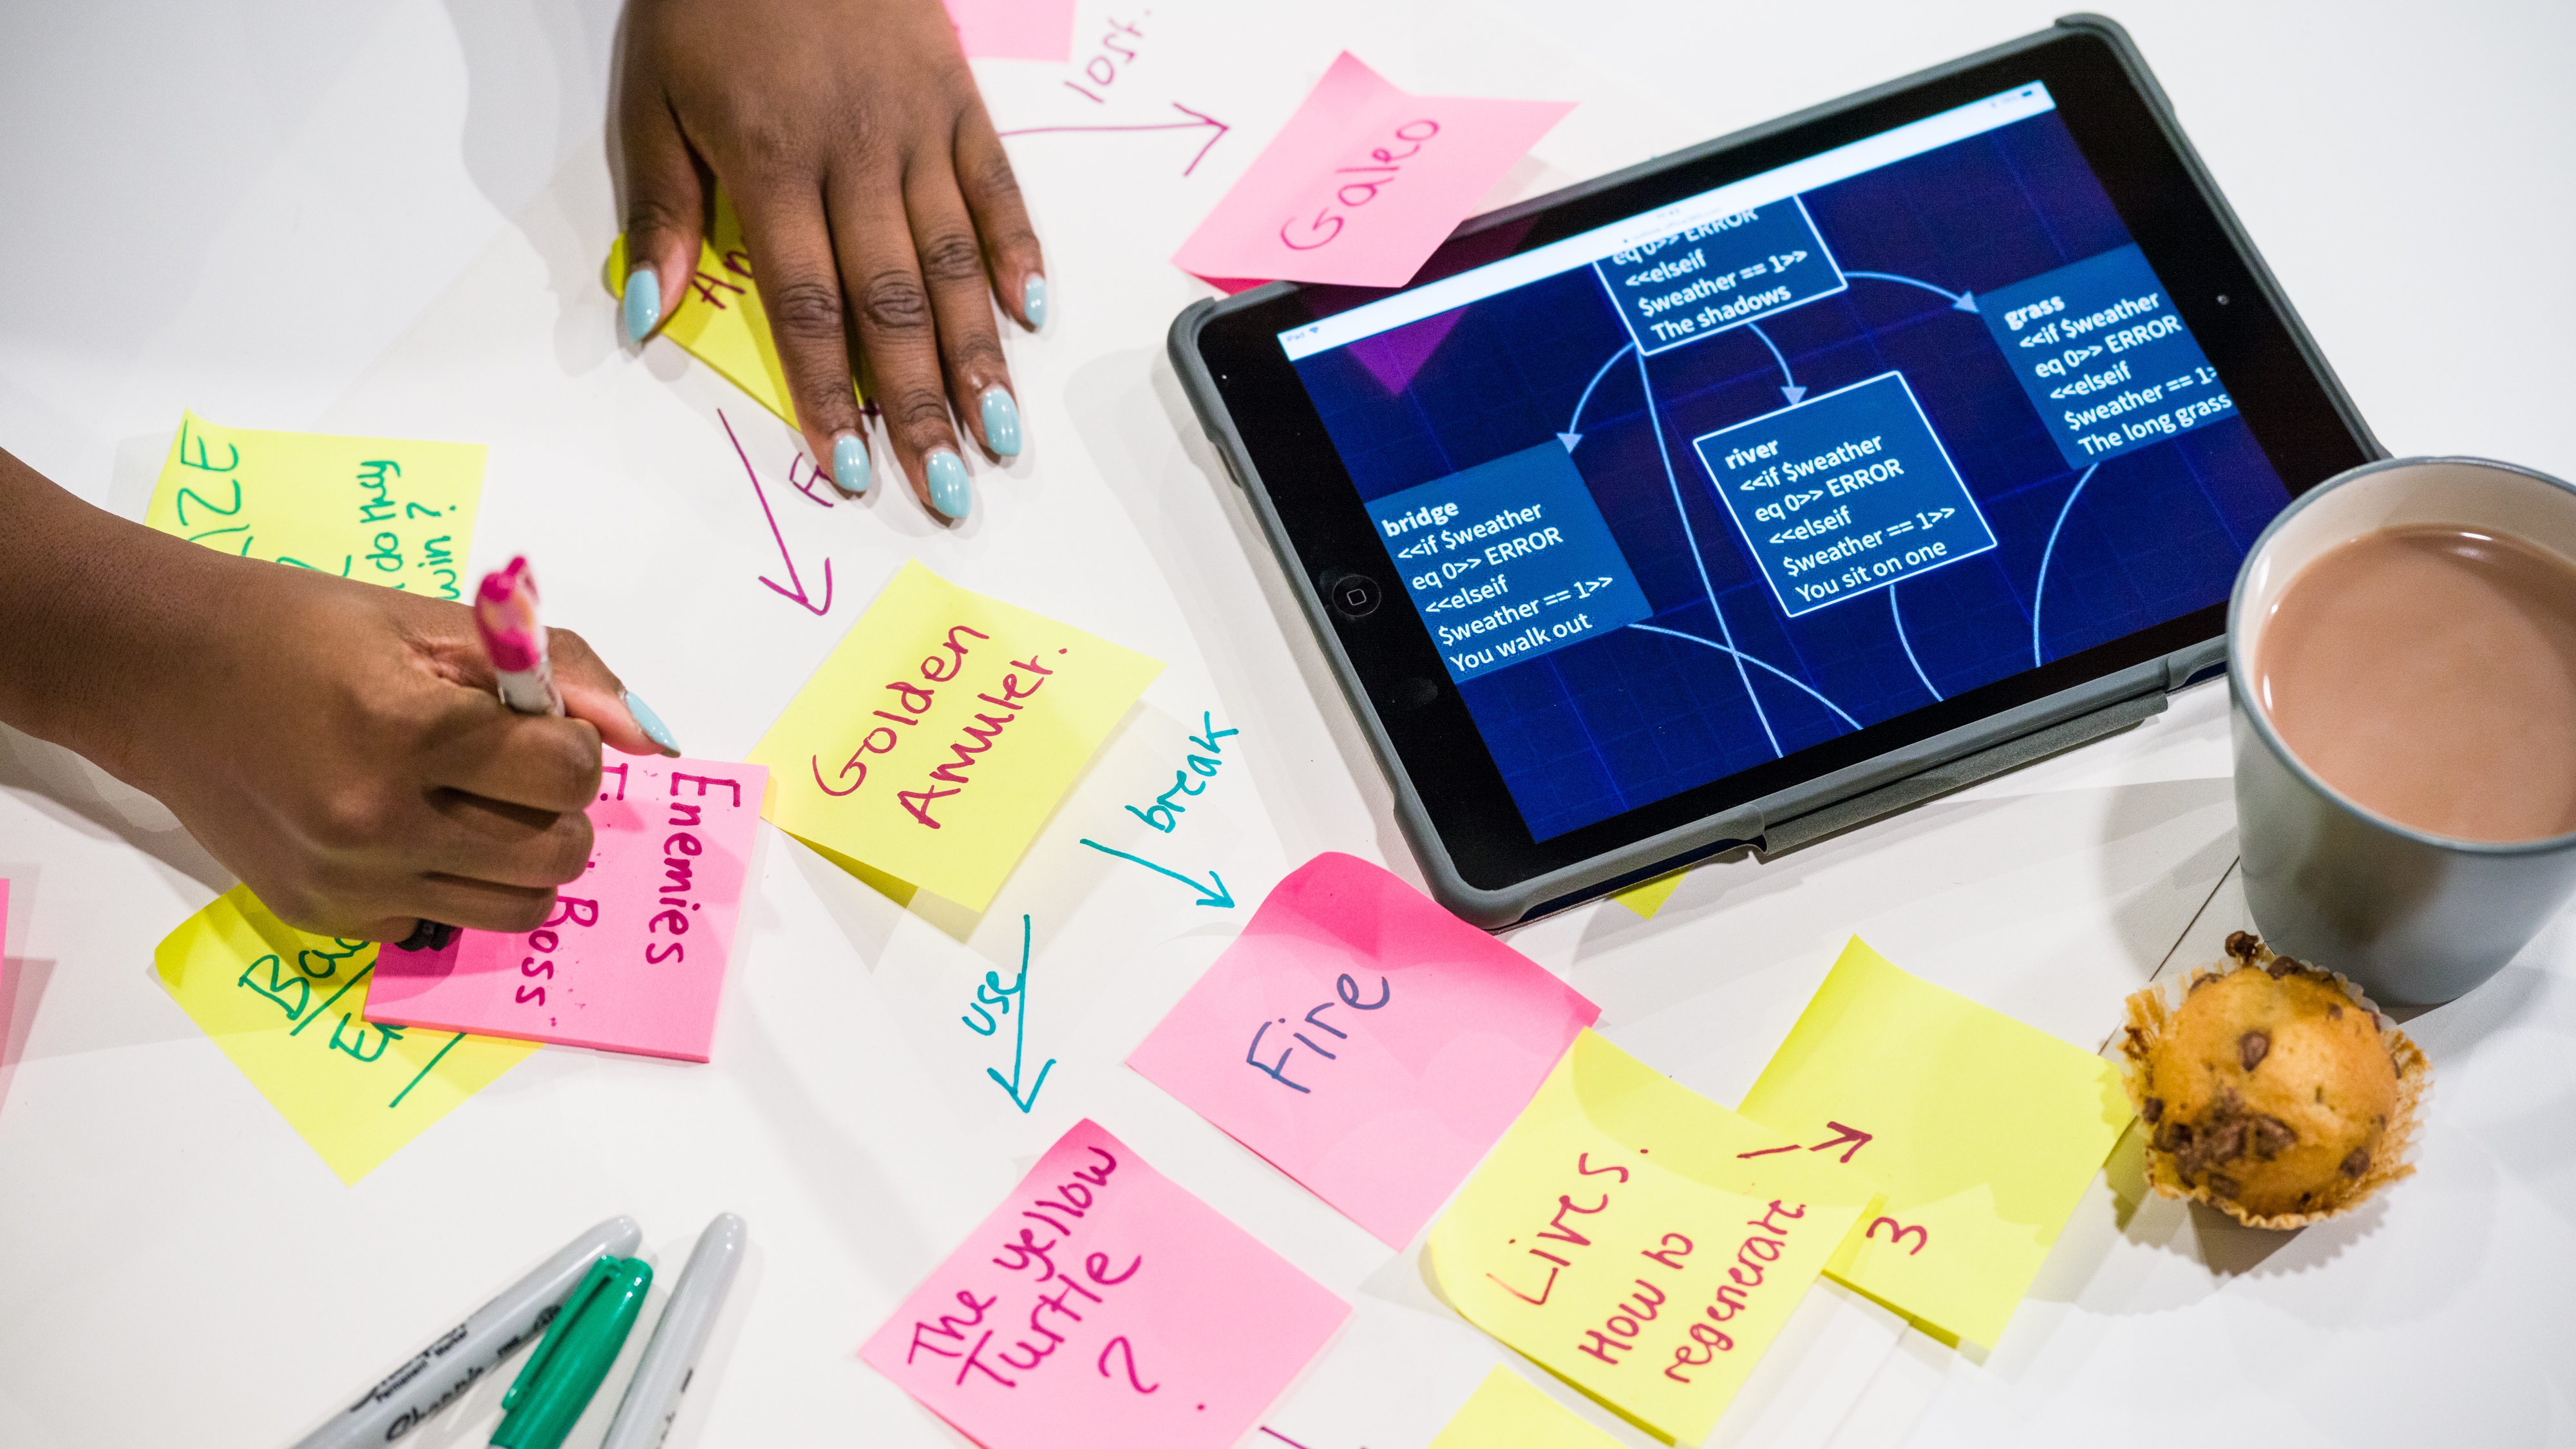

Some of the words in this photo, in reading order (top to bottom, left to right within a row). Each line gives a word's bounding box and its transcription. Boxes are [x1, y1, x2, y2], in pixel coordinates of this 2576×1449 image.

[1064, 9, 1151, 104] lost.
[1625, 248, 1707, 287] <<elseif
[1638, 270, 1737, 317] $weather
[1739, 263, 1767, 280] ==
[1768, 250, 1808, 273] 1>>
[1650, 317, 1695, 341] The
[1696, 285, 1792, 328] shadows
[2005, 296, 2065, 331] grass
[2020, 323, 2060, 348] <<if
[2061, 292, 2160, 339] $weather
[2035, 358, 2066, 377] eq
[2063, 345, 2103, 368] 0>>
[2105, 314, 2183, 354] ERROR
[2050, 361, 2132, 399] <<elseif
[2064, 384, 2163, 431] $weather
[2166, 375, 2194, 392] ==
[1725, 439, 1779, 469] river
[2078, 432, 2123, 455] The
[2121, 414, 2177, 442] long
[2176, 394, 2232, 428] grass
[178, 419, 254, 556] IZE
[356, 460, 401, 524] they
[1739, 467, 1781, 491] <<if
[1782, 435, 1882, 482] $weather
[1755, 502, 1786, 522] eq
[1784, 489, 1824, 512] 0>>
[1826, 458, 1905, 498] ERROR
[1381, 502, 1459, 536] bridge
[1397, 535, 1439, 559] <<if
[1441, 504, 1542, 551] $weather
[1769, 505, 1852, 544] <<elseif
[1783, 530, 1883, 578] $weather
[1886, 520, 1914, 537] ==
[1916, 507, 1955, 530] 1>>
[365, 532, 403, 572] do
[1411, 569, 1443, 590] eq
[1441, 558, 1482, 580] 0>>
[1484, 527, 1564, 566] ERROR
[1795, 579, 1840, 603] You
[1842, 566, 1871, 588] sit
[1873, 558, 1904, 578] on
[1905, 542, 1947, 566] one
[1425, 574, 1508, 613] <<elseif
[1438, 598, 1539, 647] $weather
[1543, 590, 1571, 606] ==
[1573, 576, 1613, 600] 1>>
[1449, 647, 1494, 672] You
[1495, 627, 1551, 658] walk
[1553, 613, 1593, 639] out
[812, 625, 990, 797] Golden
[897, 648, 1068, 829] Amulet.
[1124, 711, 1239, 833] break
[646, 771, 741, 965] Enemies
[961, 971, 1025, 1037] use
[1246, 973, 1390, 1094] Fire
[907, 1289, 997, 1365] The
[992, 1146, 1117, 1283] yellow
[1866, 1216, 1928, 1256] 3
[956, 1251, 1142, 1388] Turtle
[1578, 1279, 1666, 1365] How
[1641, 1233, 1694, 1270] to
[1097, 1335, 1207, 1411] ?
